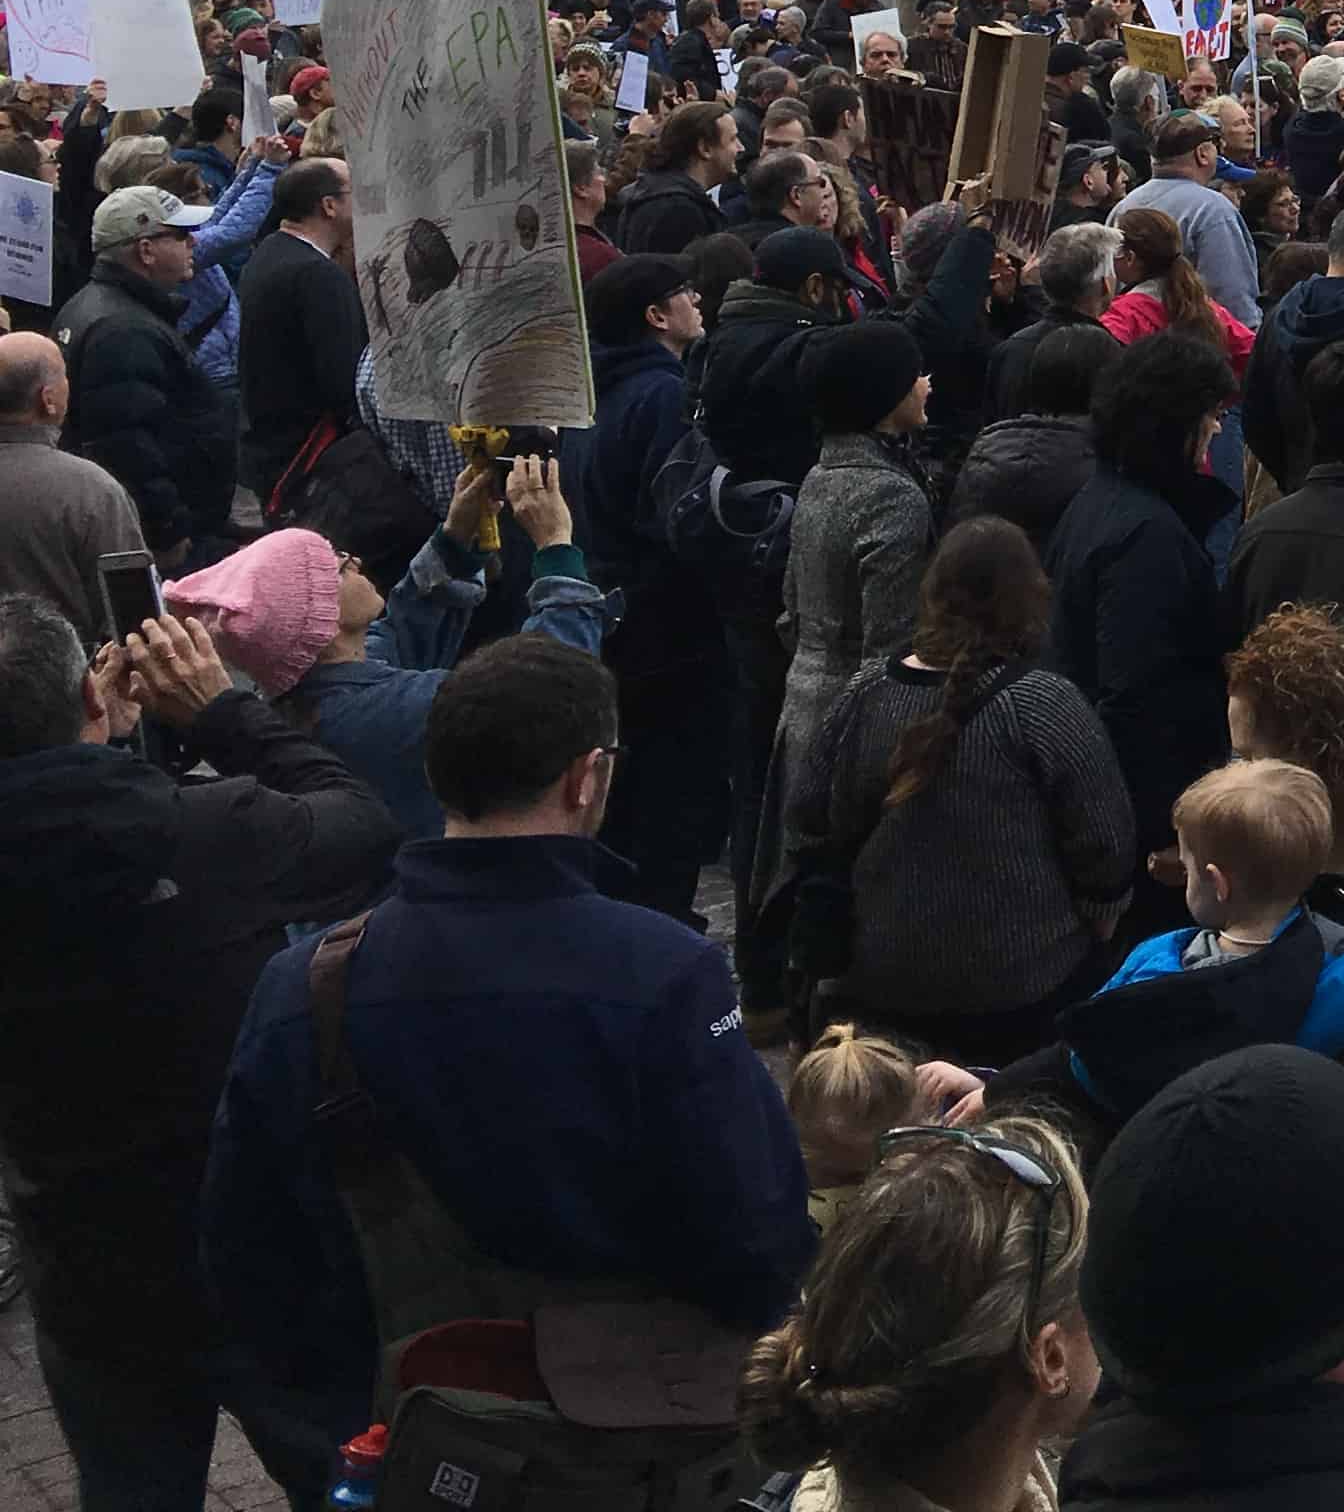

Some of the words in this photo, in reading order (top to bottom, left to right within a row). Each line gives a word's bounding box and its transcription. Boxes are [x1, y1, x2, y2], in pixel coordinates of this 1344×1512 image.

[342, 7, 400, 140] WITHOUT
[401, 56, 431, 120] THE
[446, 5, 519, 104] EPA
